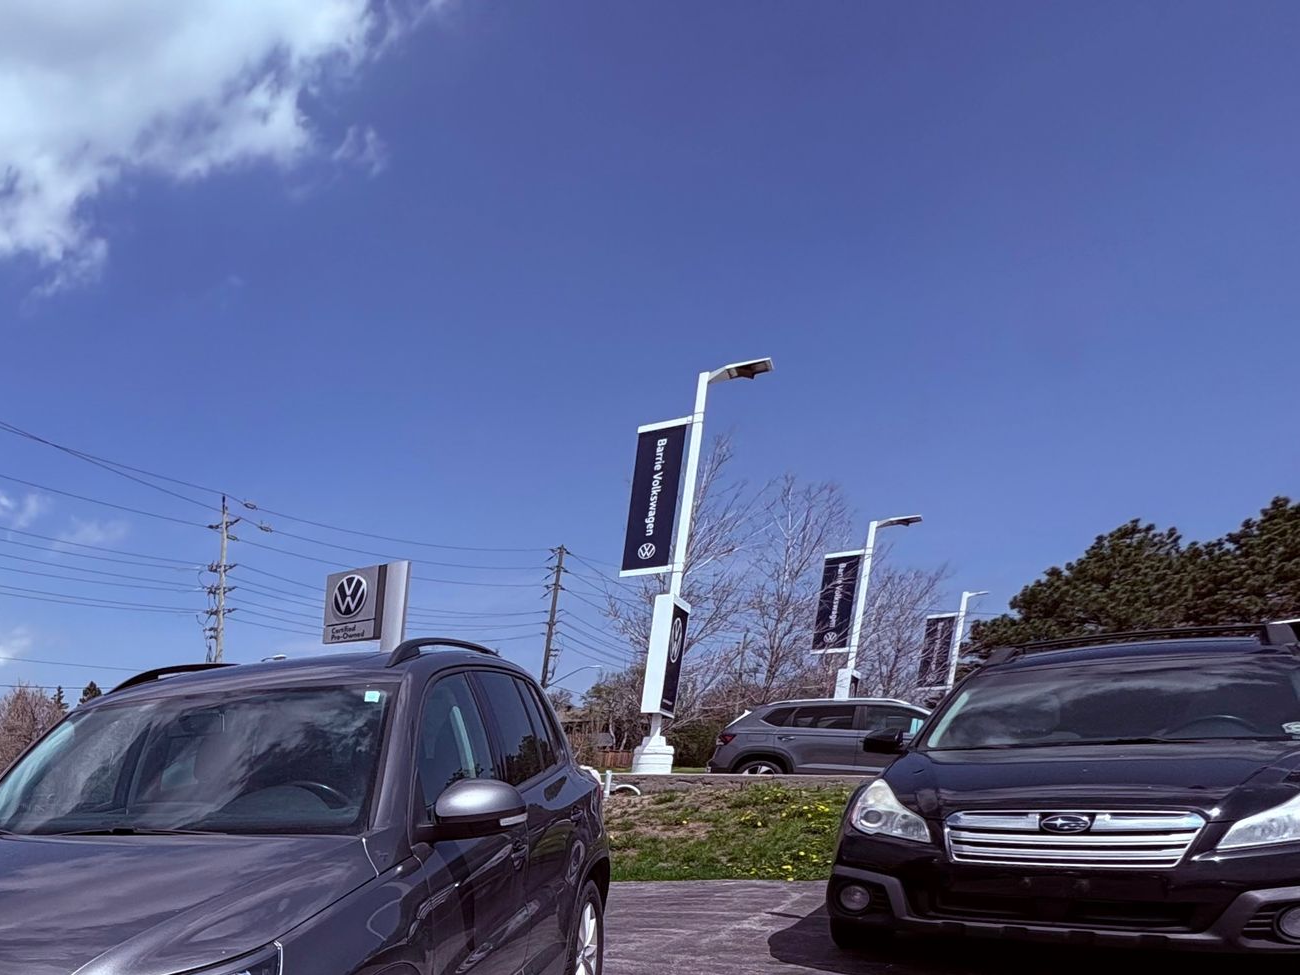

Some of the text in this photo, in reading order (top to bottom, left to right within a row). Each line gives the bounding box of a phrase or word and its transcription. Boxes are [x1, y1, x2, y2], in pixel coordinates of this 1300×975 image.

[644, 438, 667, 536] Barrie Volkswagen
[331, 625, 356, 634] Certified
[331, 630, 365, 640] Pre-Owned
